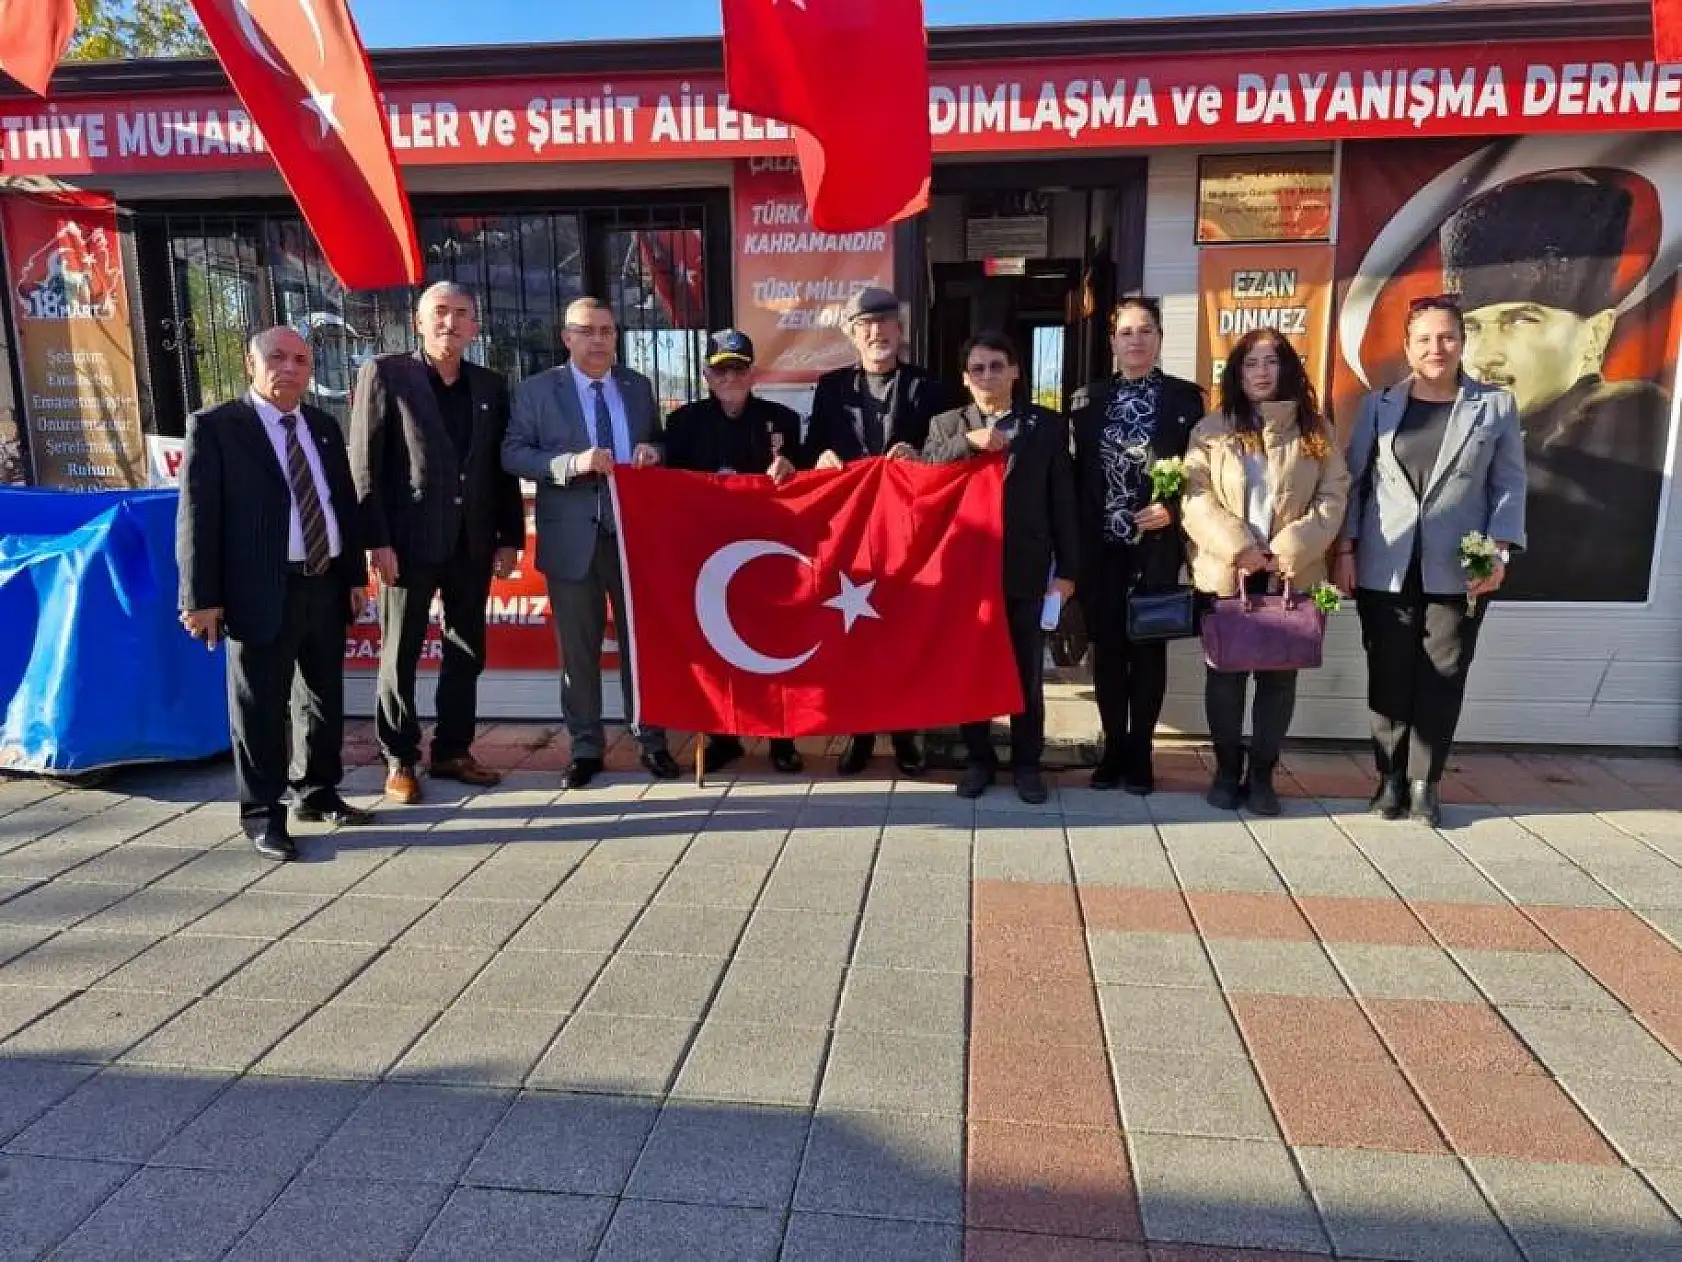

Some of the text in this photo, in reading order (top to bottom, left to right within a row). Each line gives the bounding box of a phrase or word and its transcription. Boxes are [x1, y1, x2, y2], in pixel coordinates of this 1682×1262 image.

[0, 103, 108, 160] THİYE
[379, 92, 460, 148] LER
[469, 109, 517, 147] ve
[527, 84, 639, 153] ŞEHİT
[928, 78, 1159, 138] DIMLAŞMA
[1172, 85, 1223, 126] ve
[1236, 64, 1508, 129] DAYANIŞMA
[752, 200, 801, 225] TÜRK
[744, 230, 887, 254] KAHRAMANDIR
[1232, 270, 1297, 298] EZAN
